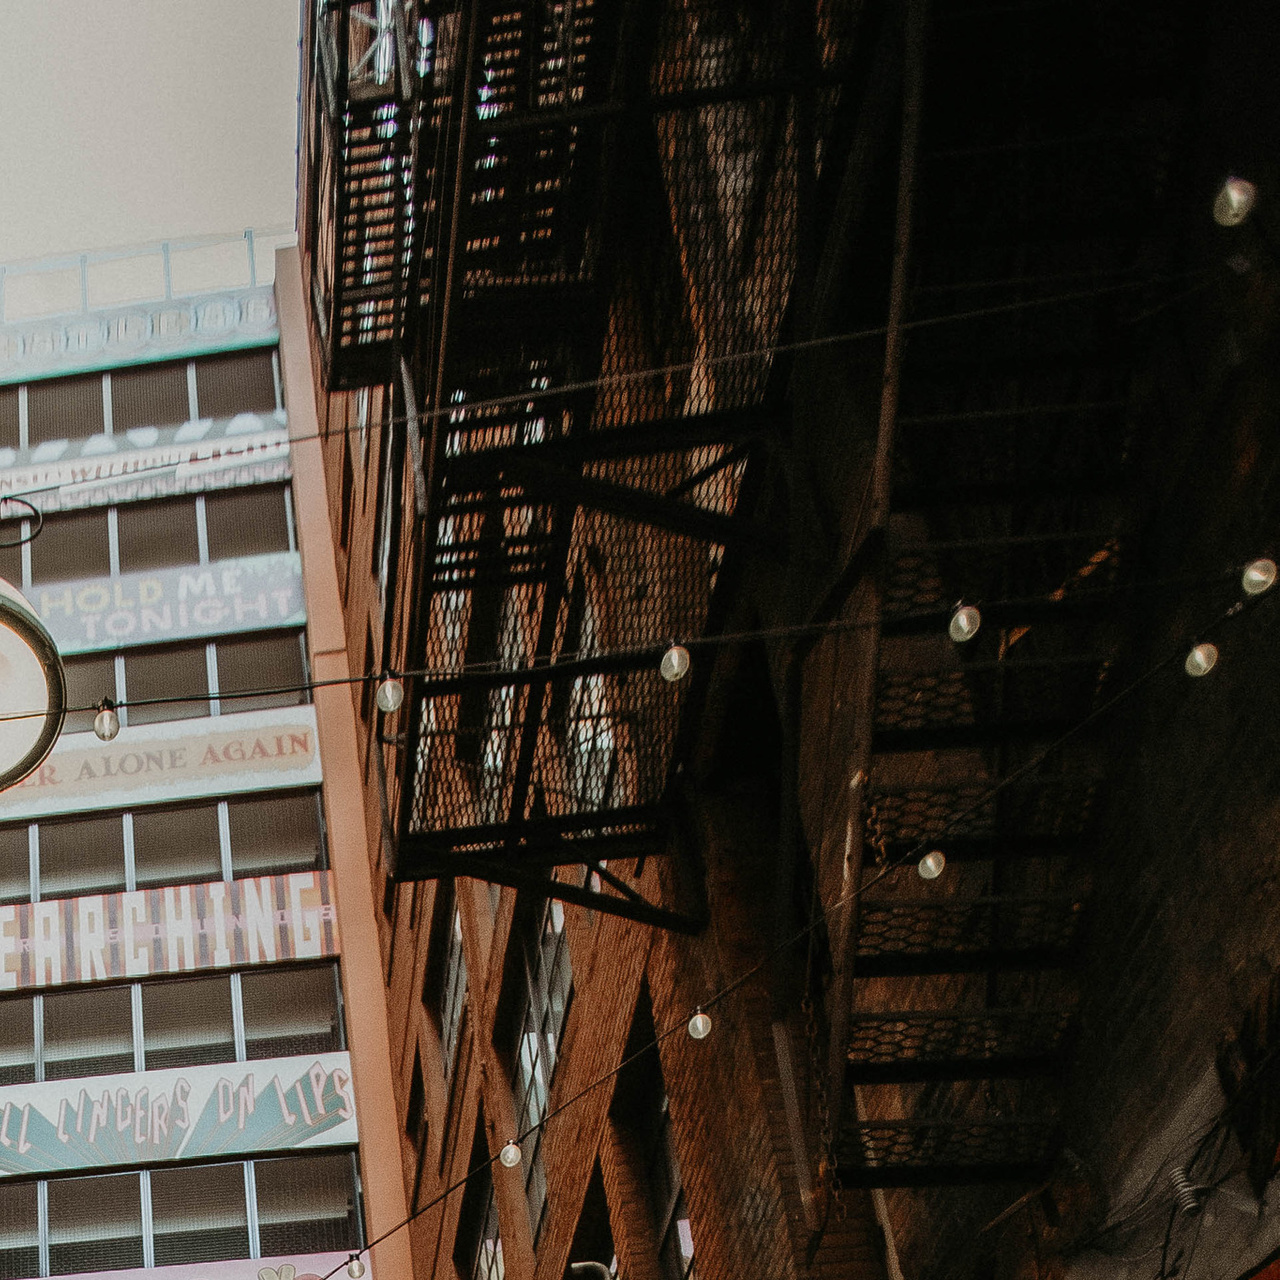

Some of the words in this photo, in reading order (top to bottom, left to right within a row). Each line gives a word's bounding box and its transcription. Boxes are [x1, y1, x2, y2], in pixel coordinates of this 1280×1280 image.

[40, 576, 163, 619] HOLD
[178, 568, 242, 601] ME
[80, 588, 293, 640] TONIGHT
[75, 747, 188, 783] ALONE
[200, 731, 312, 766] AGAIN
[56, 1077, 193, 1145] LINGERS
[217, 1072, 256, 1118] ON
[273, 1060, 355, 1127] LIPS
